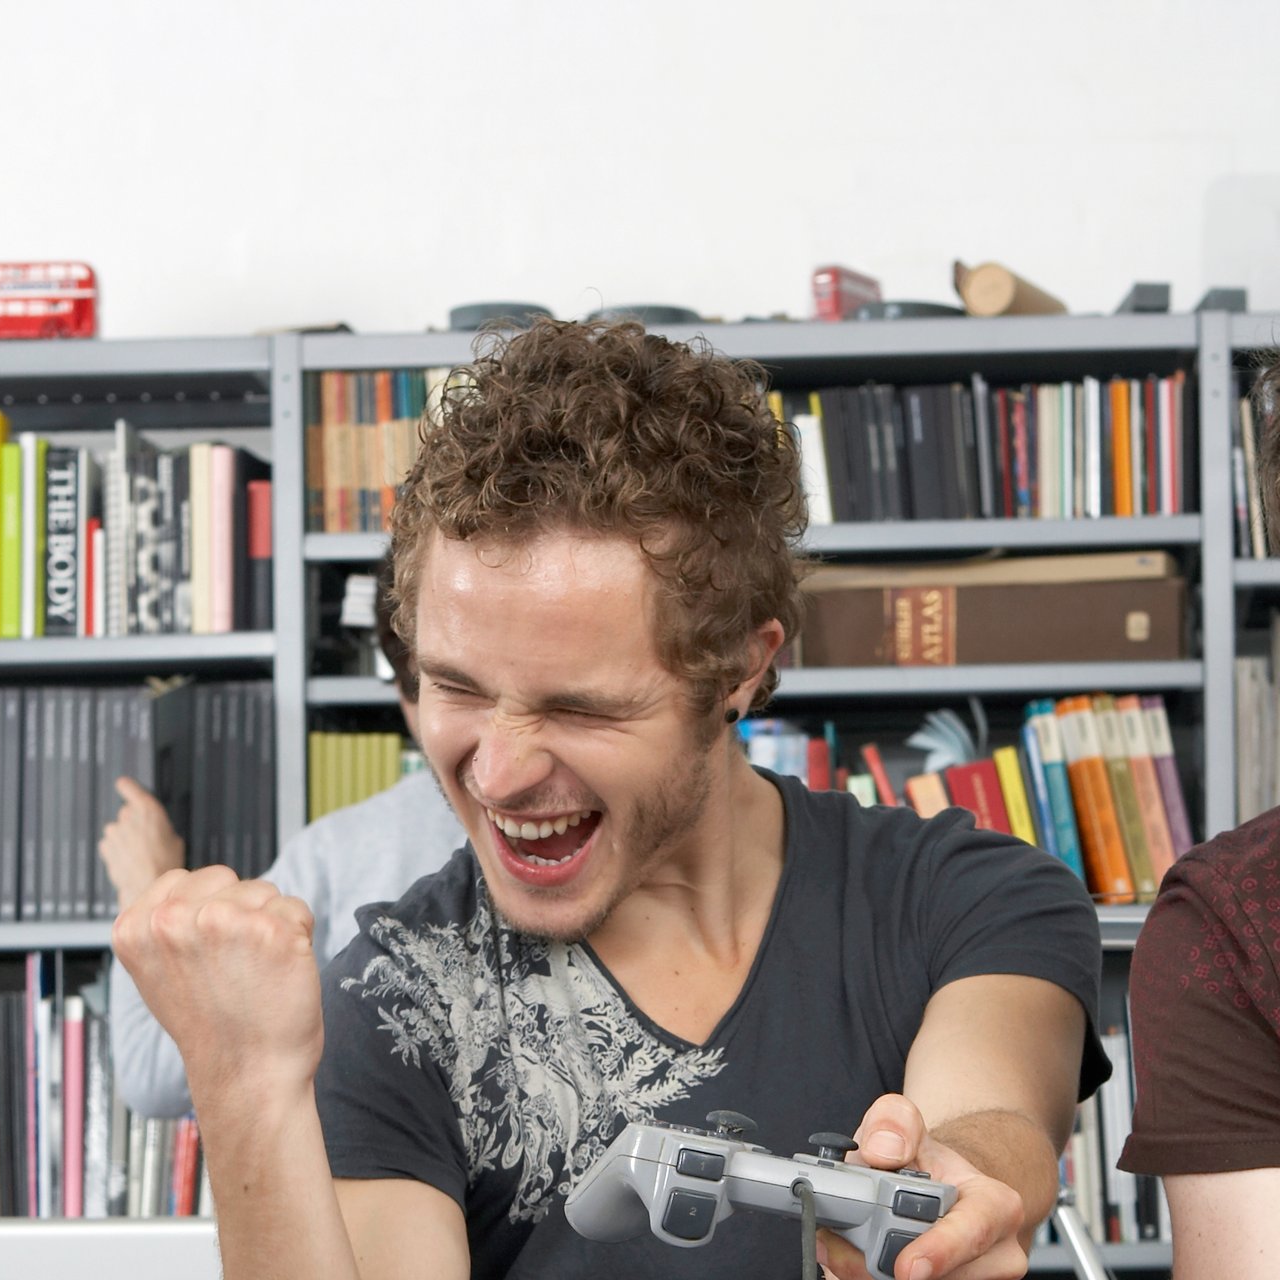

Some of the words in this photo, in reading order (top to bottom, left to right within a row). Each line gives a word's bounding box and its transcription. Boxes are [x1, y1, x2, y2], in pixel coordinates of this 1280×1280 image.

[46, 460, 77, 534] THE
[46, 534, 77, 623] BODY
[919, 590, 943, 664] ATLAS
